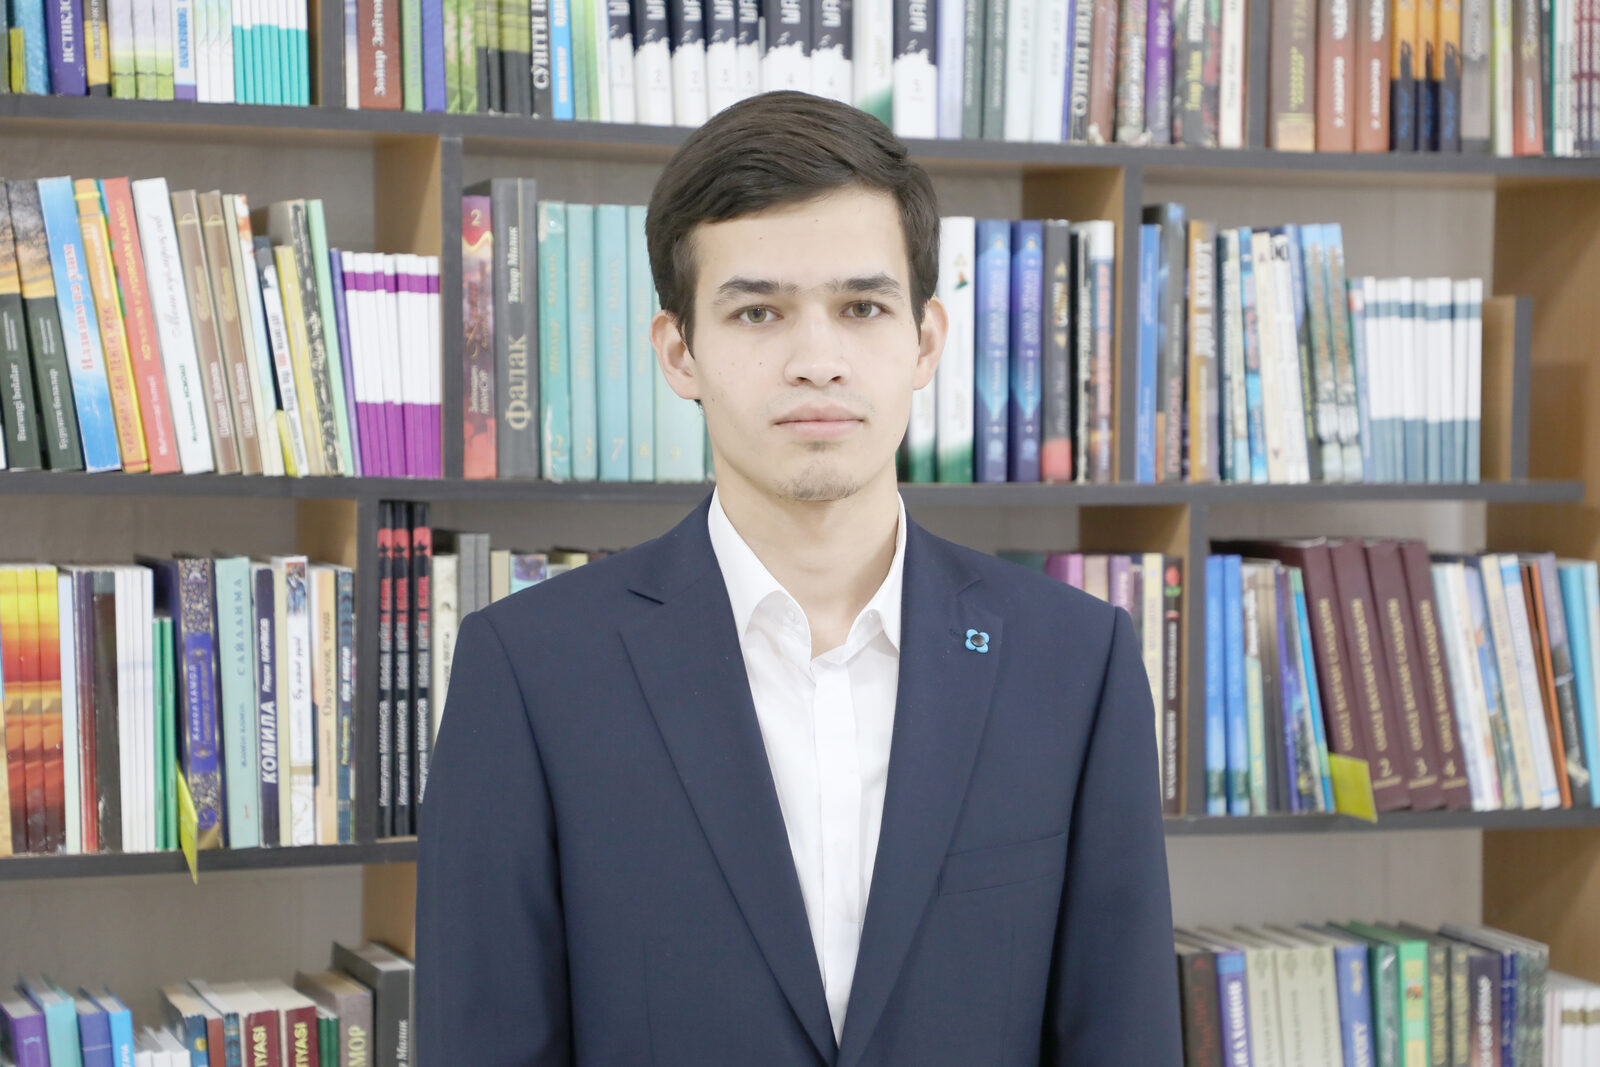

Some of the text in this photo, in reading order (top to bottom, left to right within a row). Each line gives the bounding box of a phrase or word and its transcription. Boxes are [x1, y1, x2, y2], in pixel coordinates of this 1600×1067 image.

[470, 208, 480, 225] 2
[1190, 237, 1213, 307] КИХОТ
[1190, 312, 1214, 357] ДОН
[503, 333, 531, 430] Фалак
[611, 438, 625, 460] 7
[232, 577, 245, 676] САЙЛАНМА
[258, 700, 278, 783] КОМИЛА
[1379, 757, 1392, 777] 2
[1415, 757, 1427, 776] 3
[1442, 757, 1456, 777] 4
